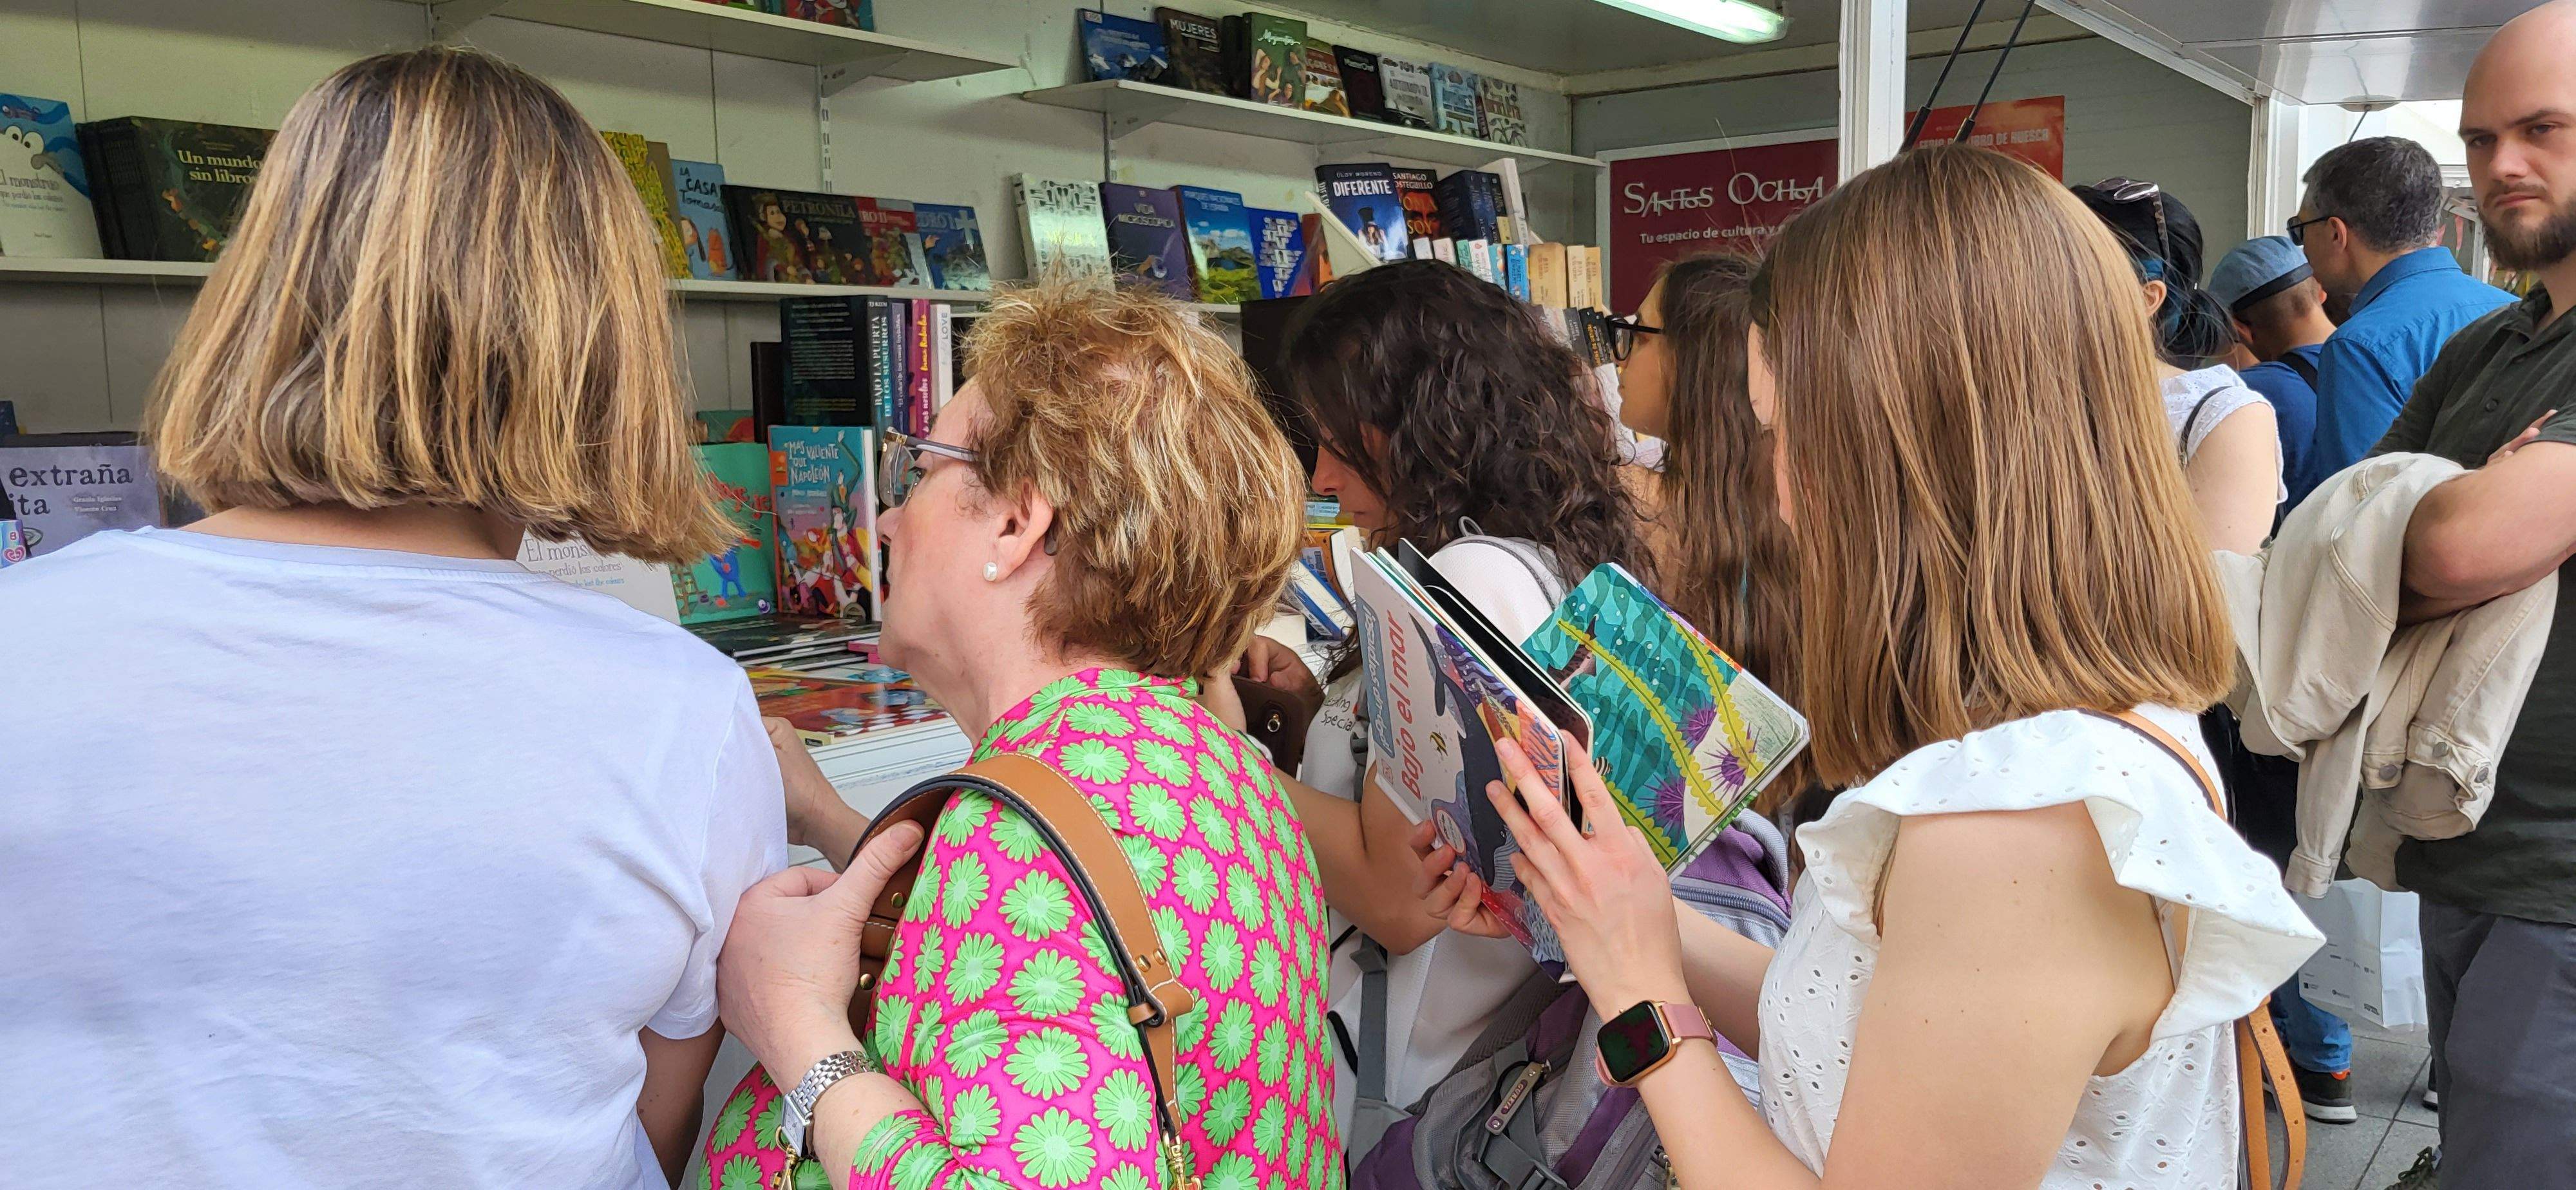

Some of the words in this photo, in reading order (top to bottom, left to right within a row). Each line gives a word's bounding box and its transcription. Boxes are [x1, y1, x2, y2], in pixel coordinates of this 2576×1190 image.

[1170, 19, 1217, 39] MUJERES
[1997, 133, 2009, 146] DE
[2011, 129, 2049, 144] HUESCA
[178, 149, 204, 165] Un
[206, 155, 261, 169] mundo
[189, 167, 213, 182] sin
[1392, 172, 1427, 182] SANTIAGO
[687, 178, 718, 197] CASA
[1332, 180, 1392, 197] DIFERENTE
[1406, 218, 1432, 235] SOY
[1640, 233, 1653, 244] Tu
[1656, 228, 1700, 243] espacio
[1703, 227, 1719, 238] de
[1721, 225, 1765, 238] cultura
[871, 316, 880, 359] PUERTA
[881, 316, 889, 375] SUSURROS
[875, 379, 883, 406] BAJO
[884, 402, 891, 417] DE
[806, 443, 839, 460] VALIENTE
[793, 458, 807, 468] QUE
[9, 464, 134, 487] extraña
[790, 463, 831, 486] NAPOLEÓN
[524, 539, 544, 562] El
[1387, 609, 1410, 689] mar
[1388, 683, 1412, 724] el
[1320, 710, 1356, 732] Special
[1395, 727, 1424, 801] Bajo
